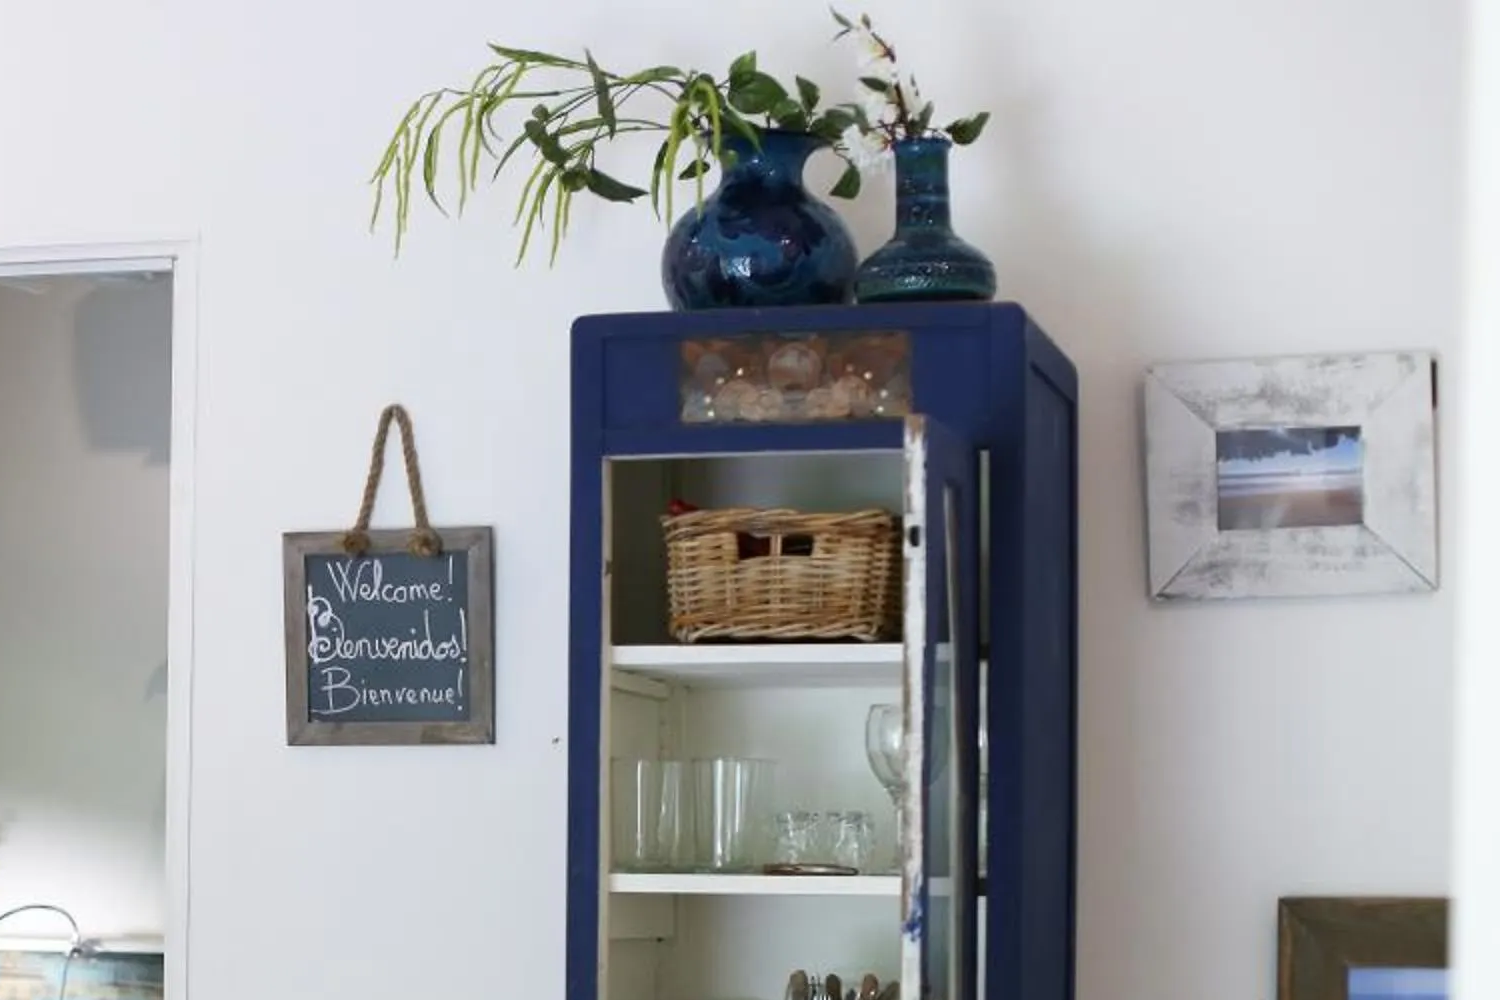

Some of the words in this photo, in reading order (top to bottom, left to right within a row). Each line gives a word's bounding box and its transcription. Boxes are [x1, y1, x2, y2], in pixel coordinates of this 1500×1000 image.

[326, 555, 453, 602] Welcome!
[307, 584, 467, 663] Bienvenidos!
[311, 667, 464, 715] Bienvenue!
